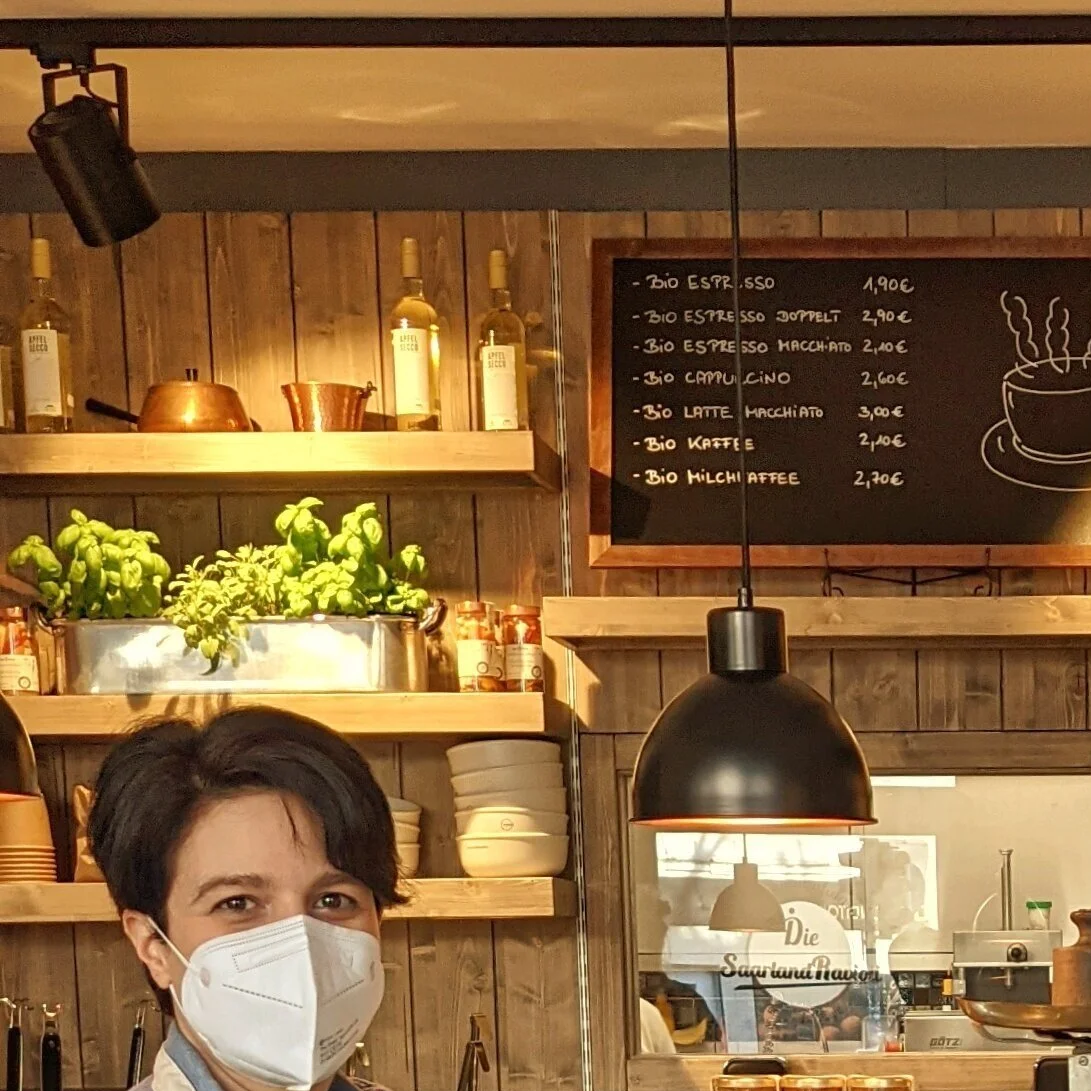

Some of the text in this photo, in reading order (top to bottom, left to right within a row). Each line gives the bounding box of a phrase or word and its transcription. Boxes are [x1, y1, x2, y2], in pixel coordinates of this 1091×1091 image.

[687, 274, 775, 290] ESPRSSO
[862, 276, 915, 295] 1,90€
[684, 308, 766, 325] ESPRESSO
[776, 309, 841, 323] DOPPELT
[862, 308, 912, 327] 2,90€
[683, 339, 769, 355] ESPRESSO
[863, 339, 909, 356] 2,10€
[684, 371, 791, 386] CAPPUCINO
[860, 371, 909, 389] 2,60€
[684, 406, 734, 419] LATTE
[858, 405, 905, 421] 3,00€
[687, 435, 755, 452] KAFFEE
[858, 432, 907, 452] 2,10€
[853, 471, 904, 489] 2,70€
[783, 908, 819, 946] Die
